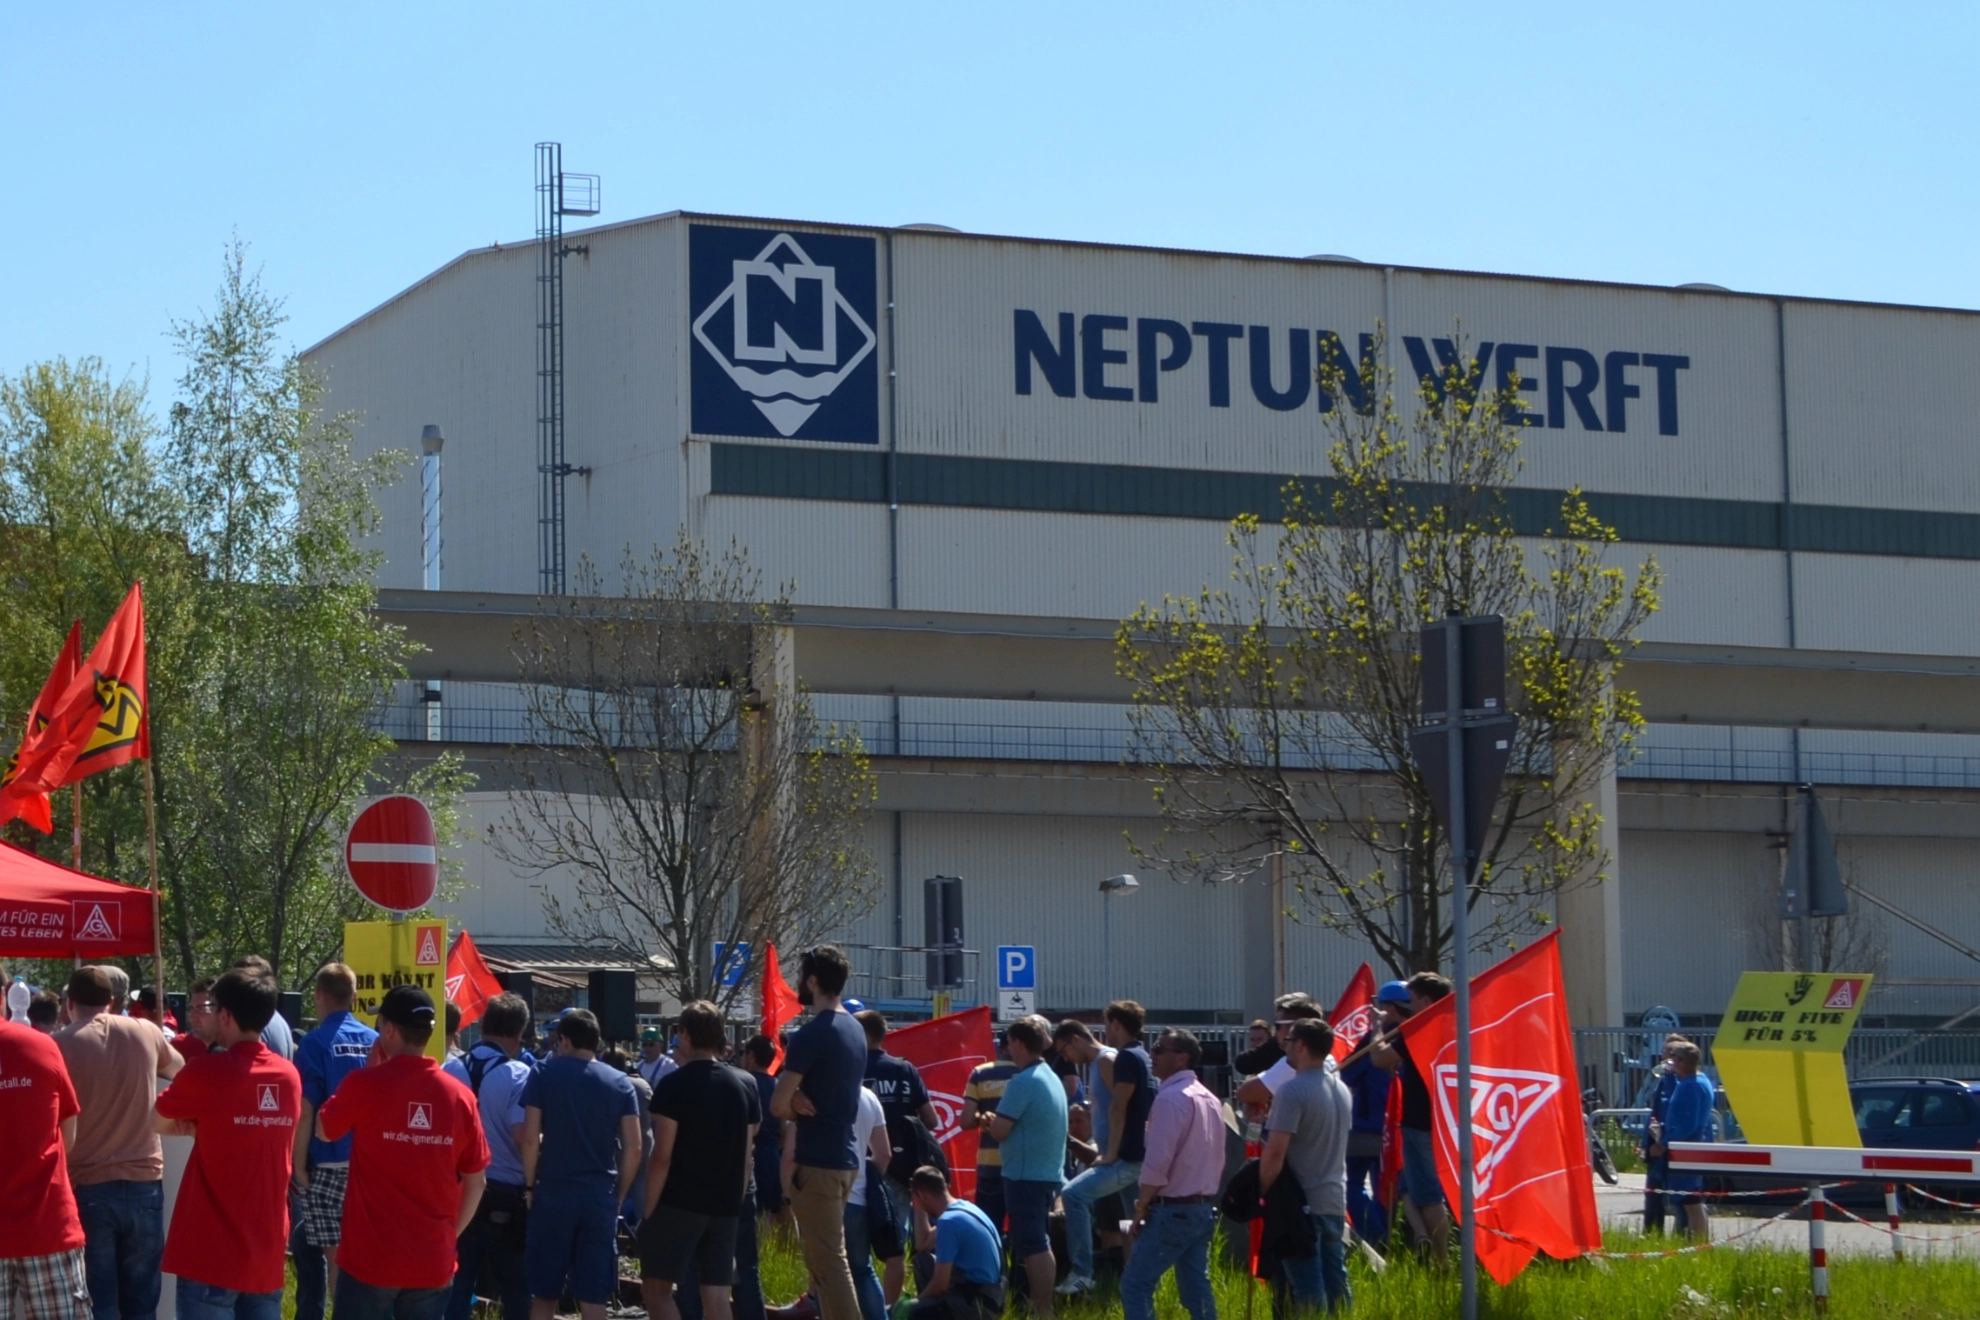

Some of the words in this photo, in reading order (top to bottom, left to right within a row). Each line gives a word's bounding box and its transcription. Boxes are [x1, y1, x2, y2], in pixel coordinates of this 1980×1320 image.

[1013, 308, 1376, 417] NEPTUN
[1401, 335, 1690, 437] WERFT
[10, 909, 38, 925] FÜR
[41, 912, 65, 926] EIN
[20, 927, 64, 938] LEBEN
[1006, 951, 1026, 984] P
[1734, 1009, 1785, 1023] HIGH
[1797, 1011, 1844, 1025] FIVE
[1743, 1027, 1784, 1042] FÜR
[1791, 1029, 1818, 1043] 5%
